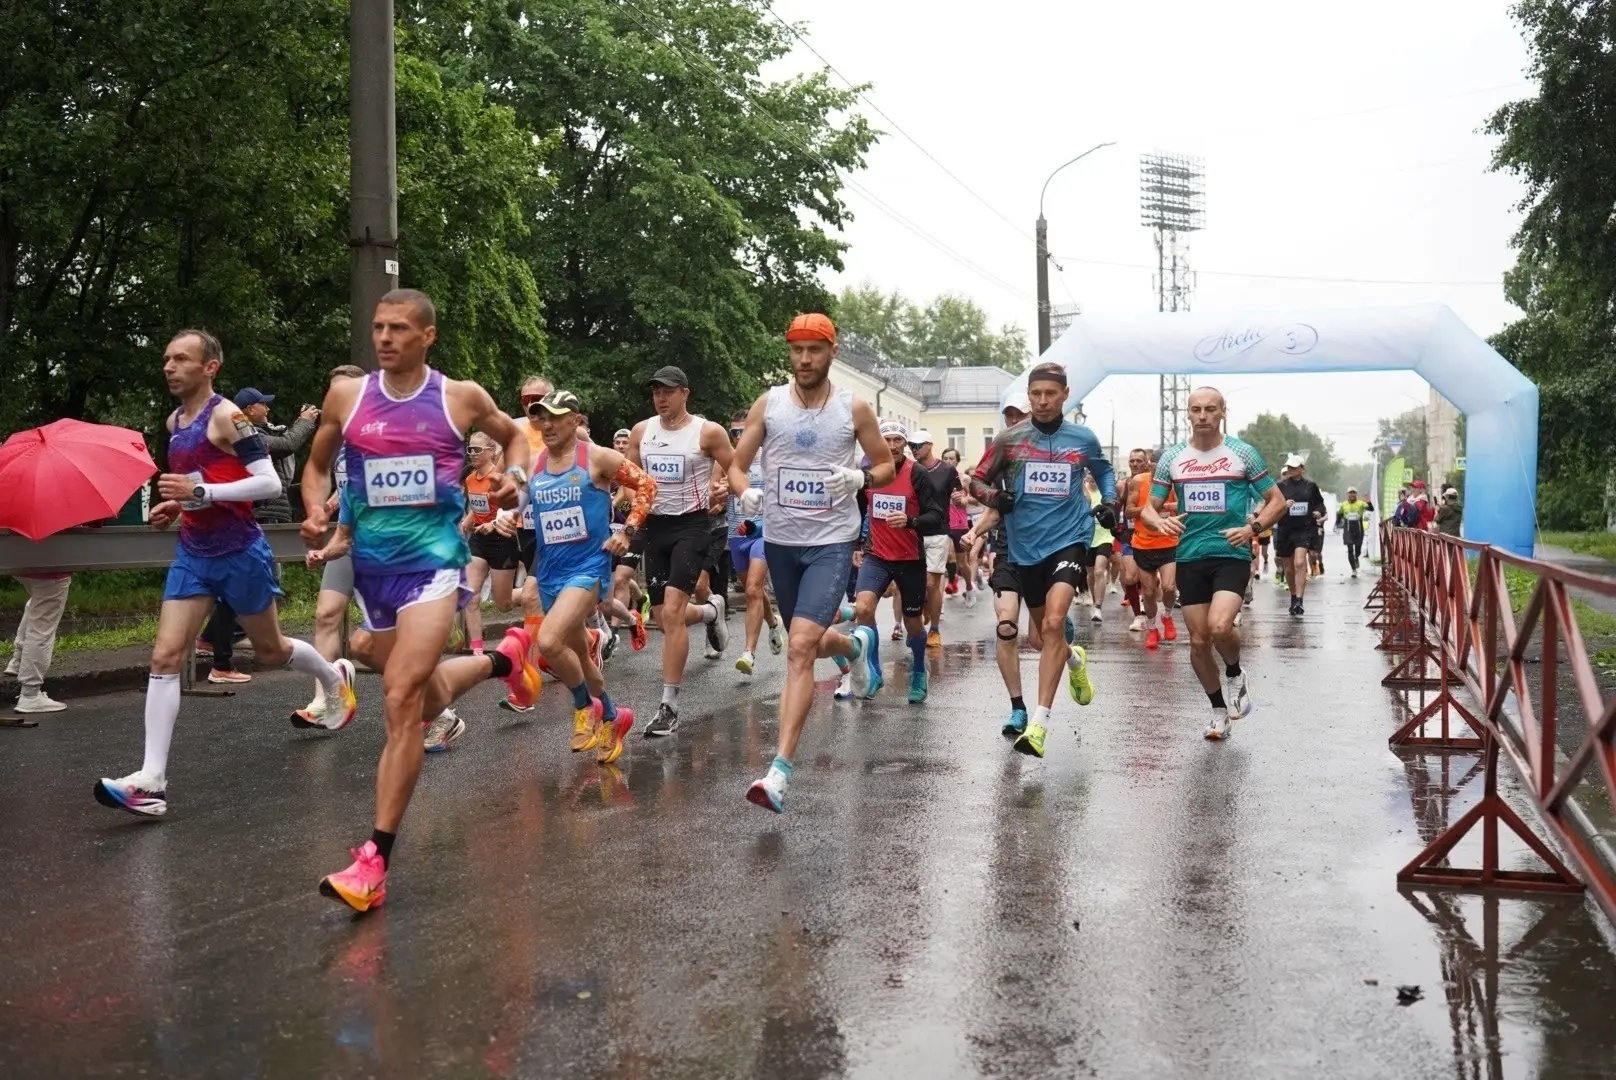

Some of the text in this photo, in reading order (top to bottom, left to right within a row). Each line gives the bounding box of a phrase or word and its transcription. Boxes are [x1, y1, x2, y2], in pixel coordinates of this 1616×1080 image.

[652, 463, 679, 473] 4031
[371, 469, 428, 488] 4070
[1029, 471, 1067, 483] 4032
[785, 480, 825, 494] 4012
[535, 486, 582, 504] RUSSIA
[1189, 491, 1220, 501] 4018
[875, 500, 903, 511] 4058
[545, 516, 580, 532] 4041
